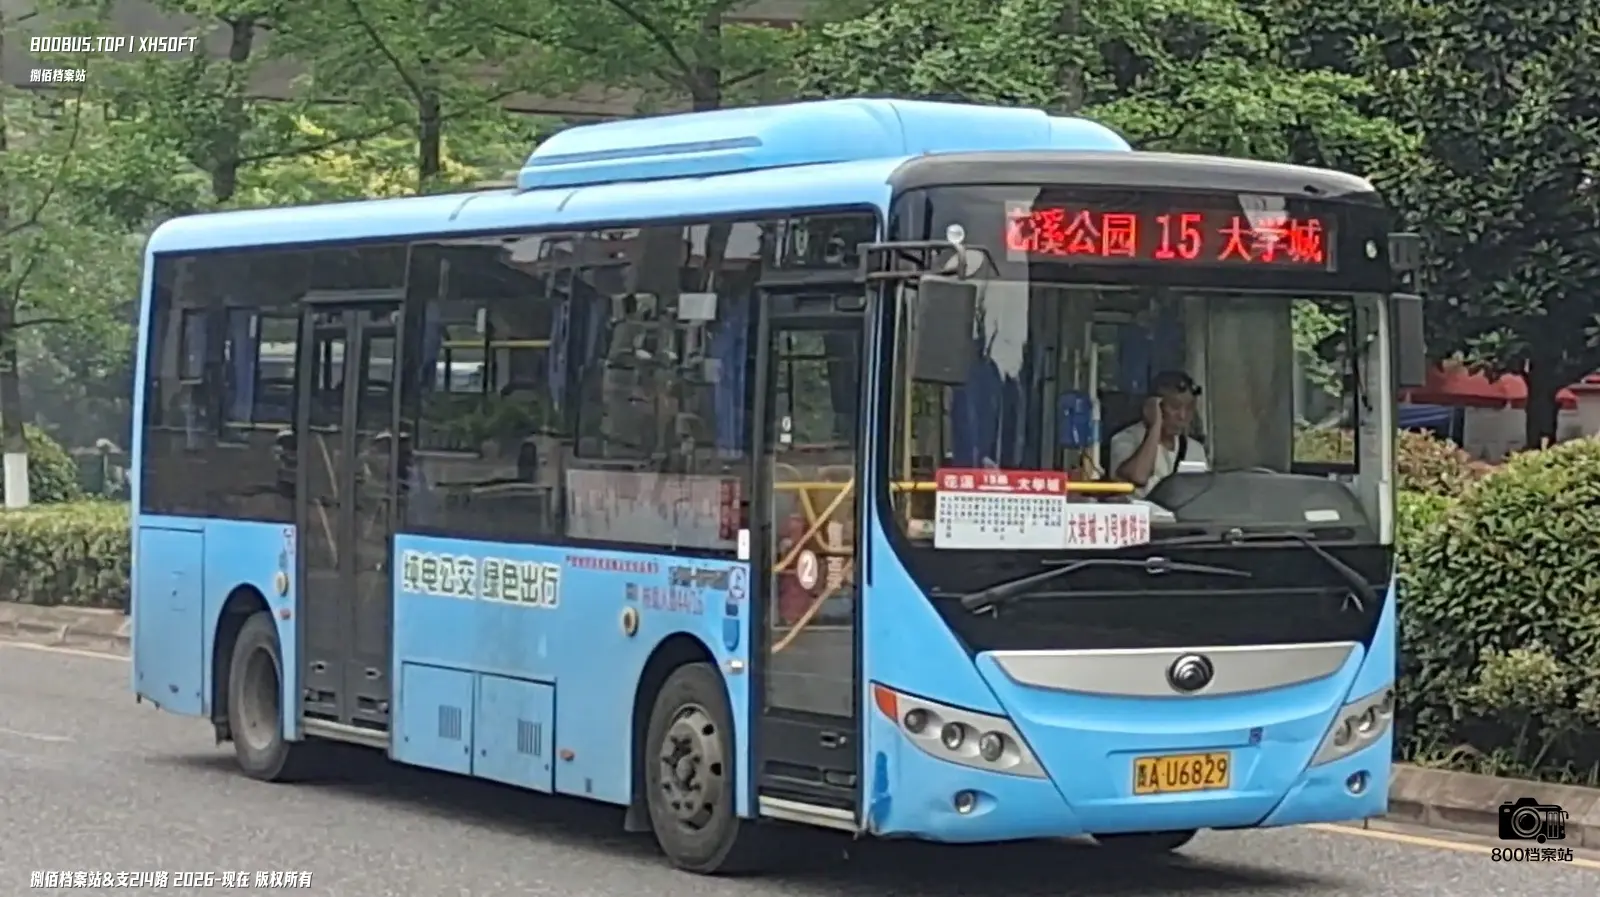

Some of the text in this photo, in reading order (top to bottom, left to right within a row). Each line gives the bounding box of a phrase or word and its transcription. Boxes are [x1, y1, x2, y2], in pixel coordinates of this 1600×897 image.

[1154, 214, 1203, 260] 15
[1217, 215, 1325, 264] 大学城
[403, 553, 475, 598] 纯电公交
[482, 558, 560, 606] 绿色出行
[801, 555, 813, 582] 2
